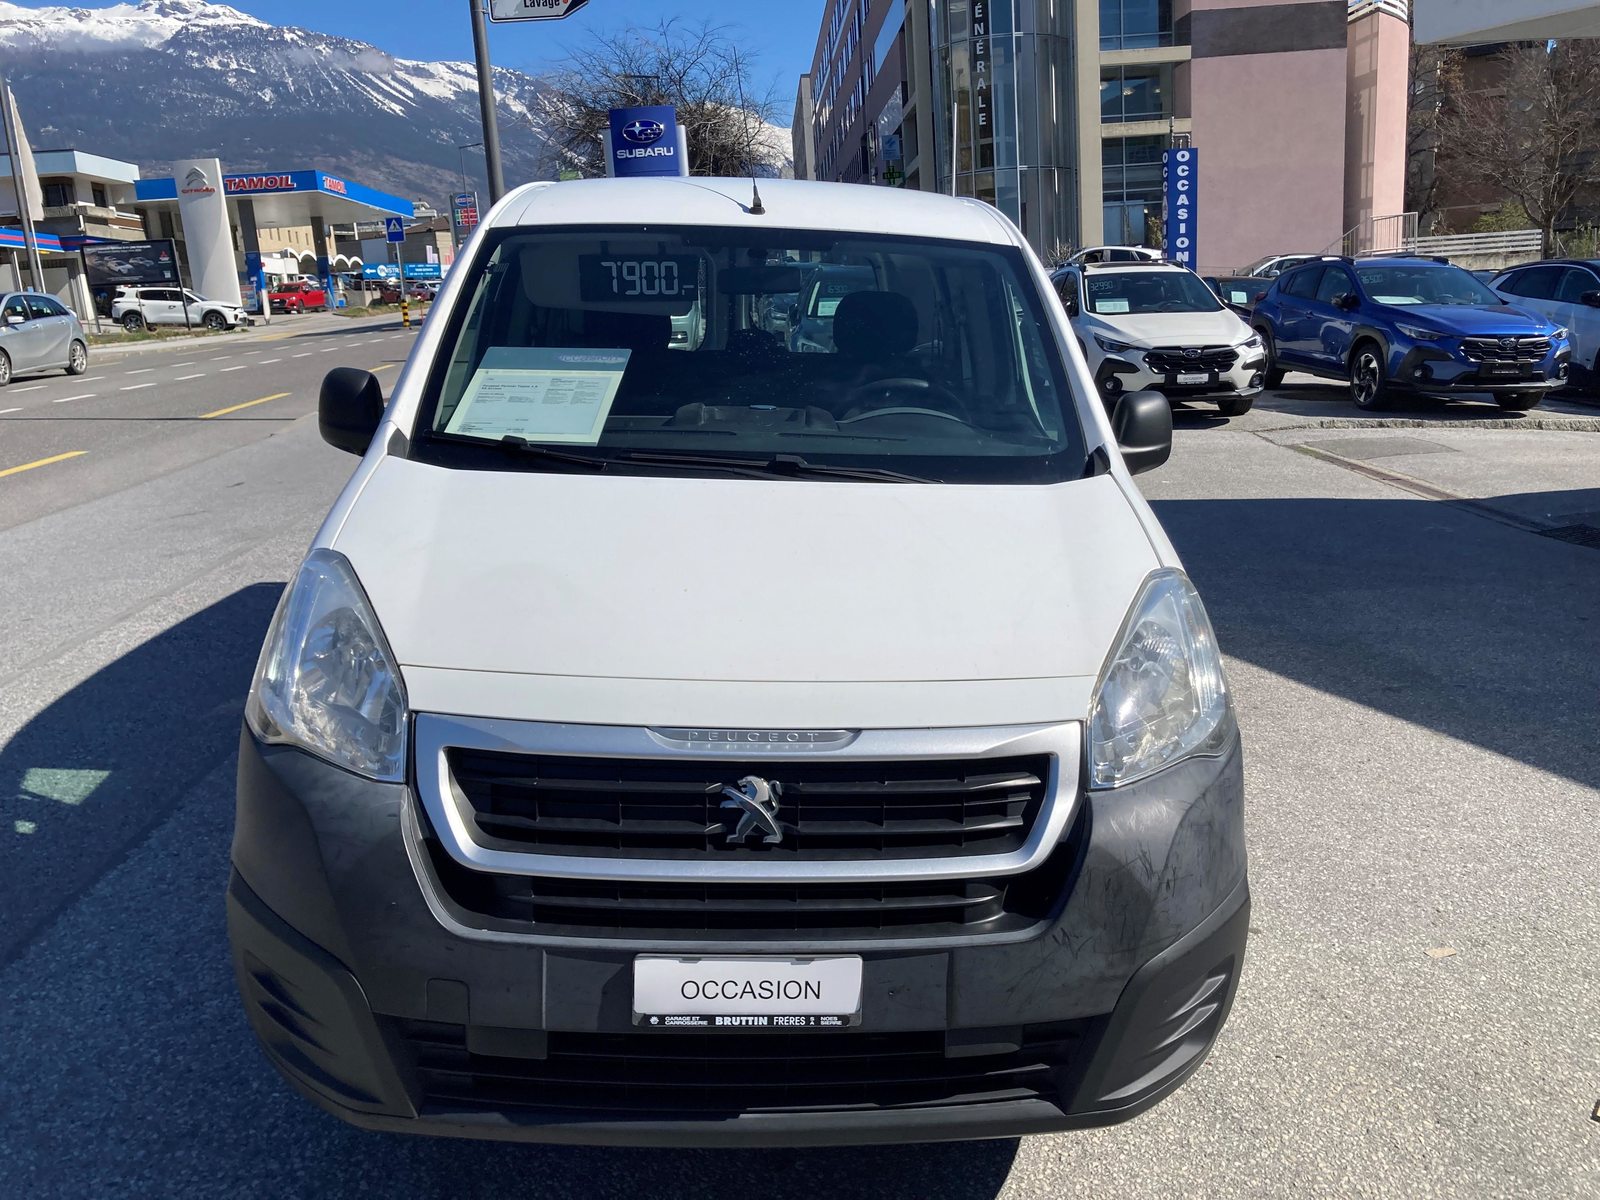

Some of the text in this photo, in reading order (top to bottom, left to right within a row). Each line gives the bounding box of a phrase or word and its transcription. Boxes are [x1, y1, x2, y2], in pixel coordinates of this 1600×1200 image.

[524, 0, 560, 9] Lavage
[973, 3, 987, 126] ÉNÉRALE
[616, 147, 674, 159] SUBARU
[224, 175, 297, 192] TAMOIL
[322, 176, 347, 194] TAMOIL
[1176, 150, 1190, 262] OCCASION
[688, 731, 818, 742] PEUGEOT
[680, 980, 822, 1000] OCCASION
[715, 1016, 768, 1026] BRUTTIN
